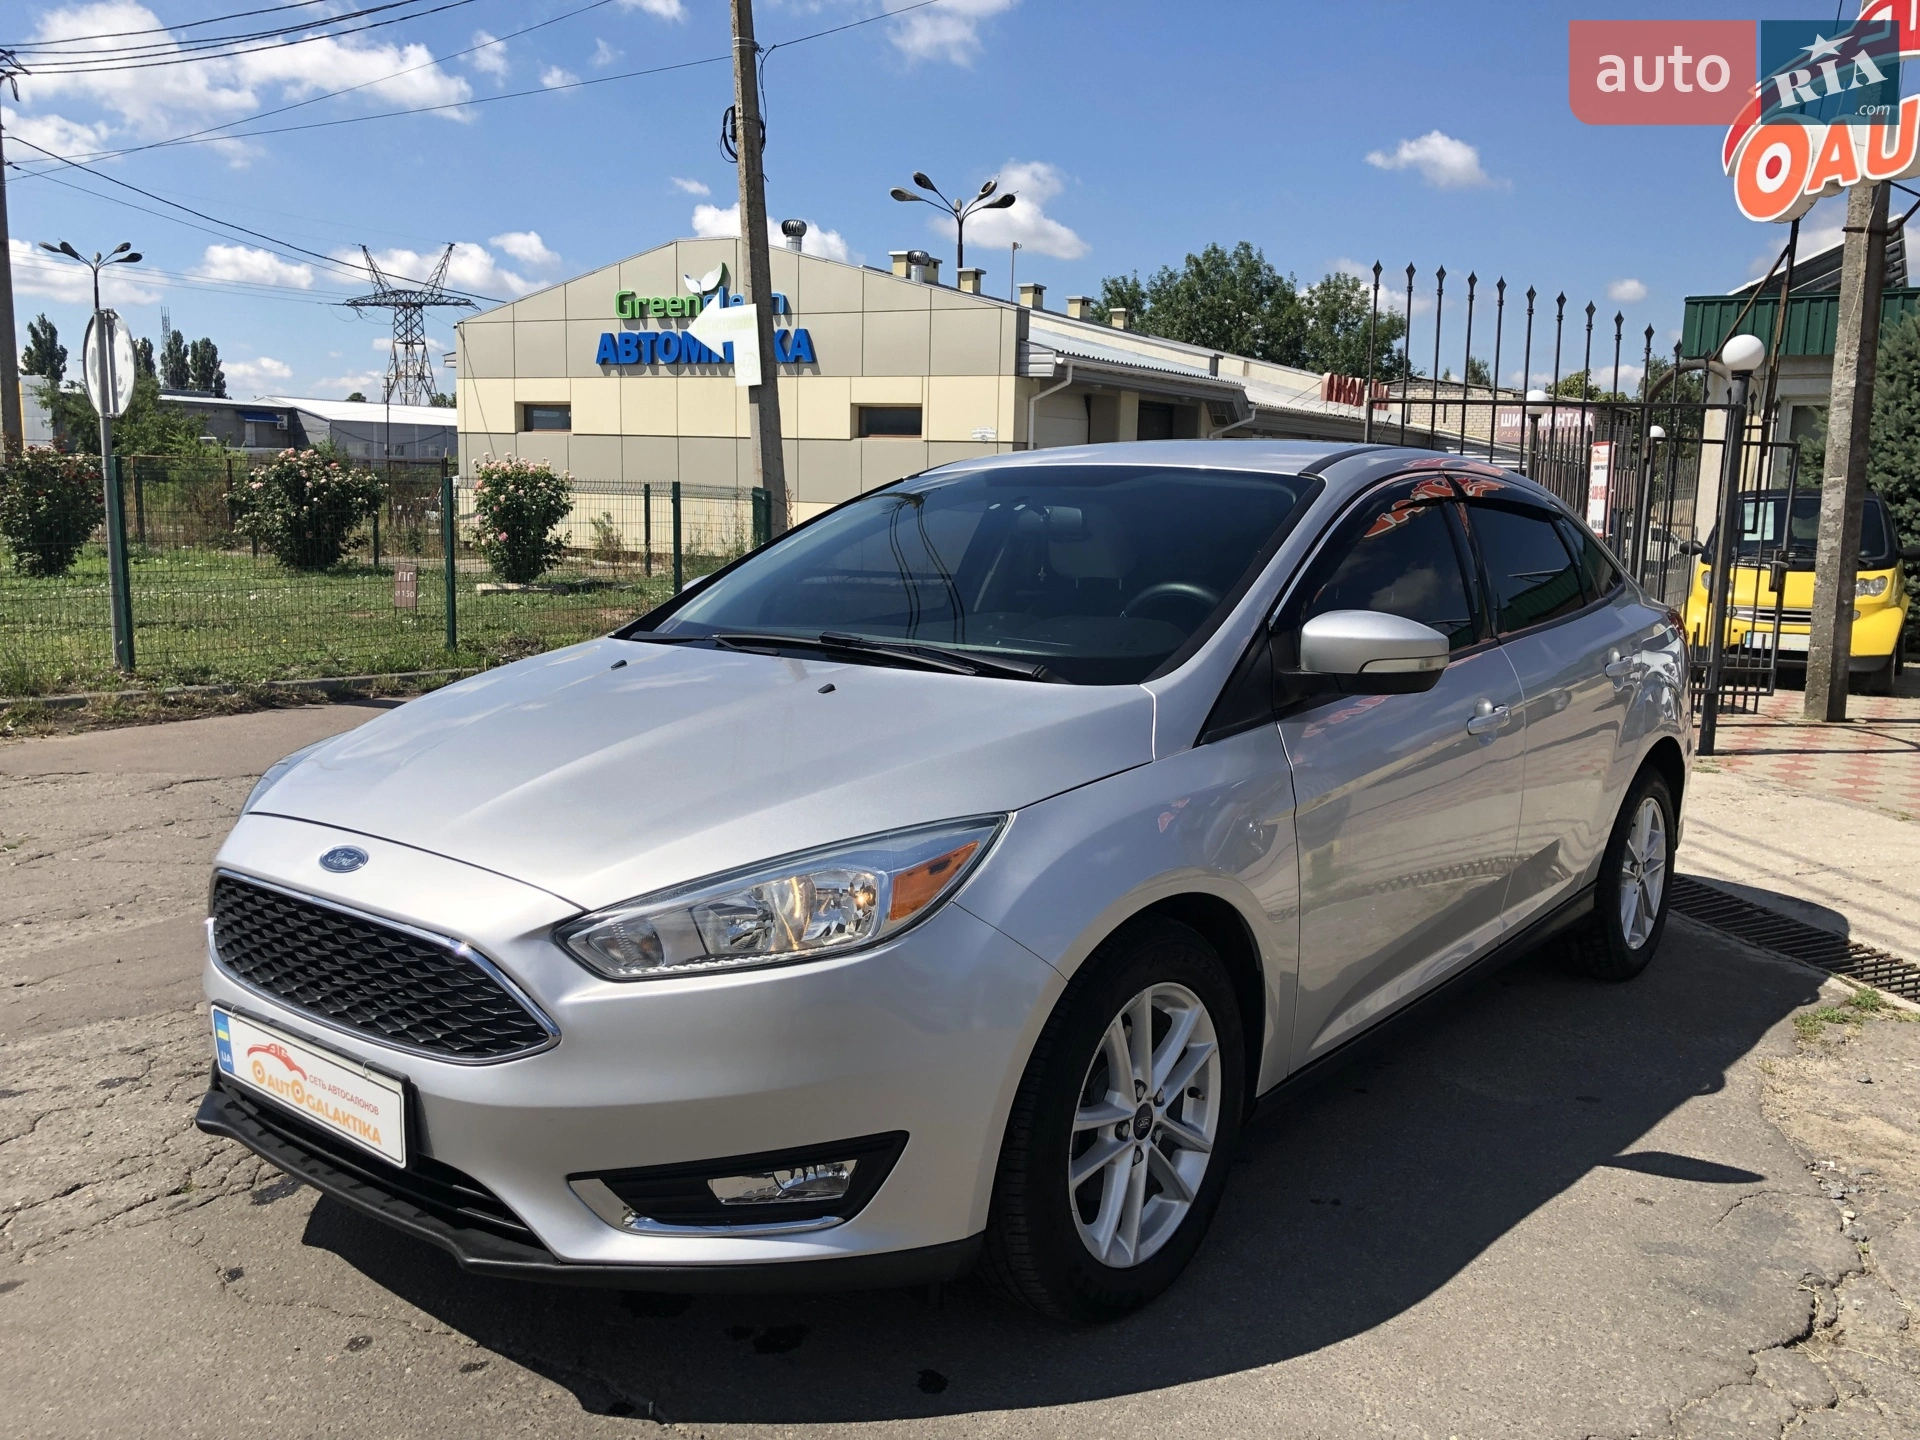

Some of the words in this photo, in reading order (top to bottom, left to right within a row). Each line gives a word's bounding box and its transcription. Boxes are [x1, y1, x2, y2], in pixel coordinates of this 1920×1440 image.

[221, 1050, 233, 1065] UA
[309, 1074, 327, 1090] СЕТЬ
[328, 1084, 380, 1116] АВТОСАЛОНОВ
